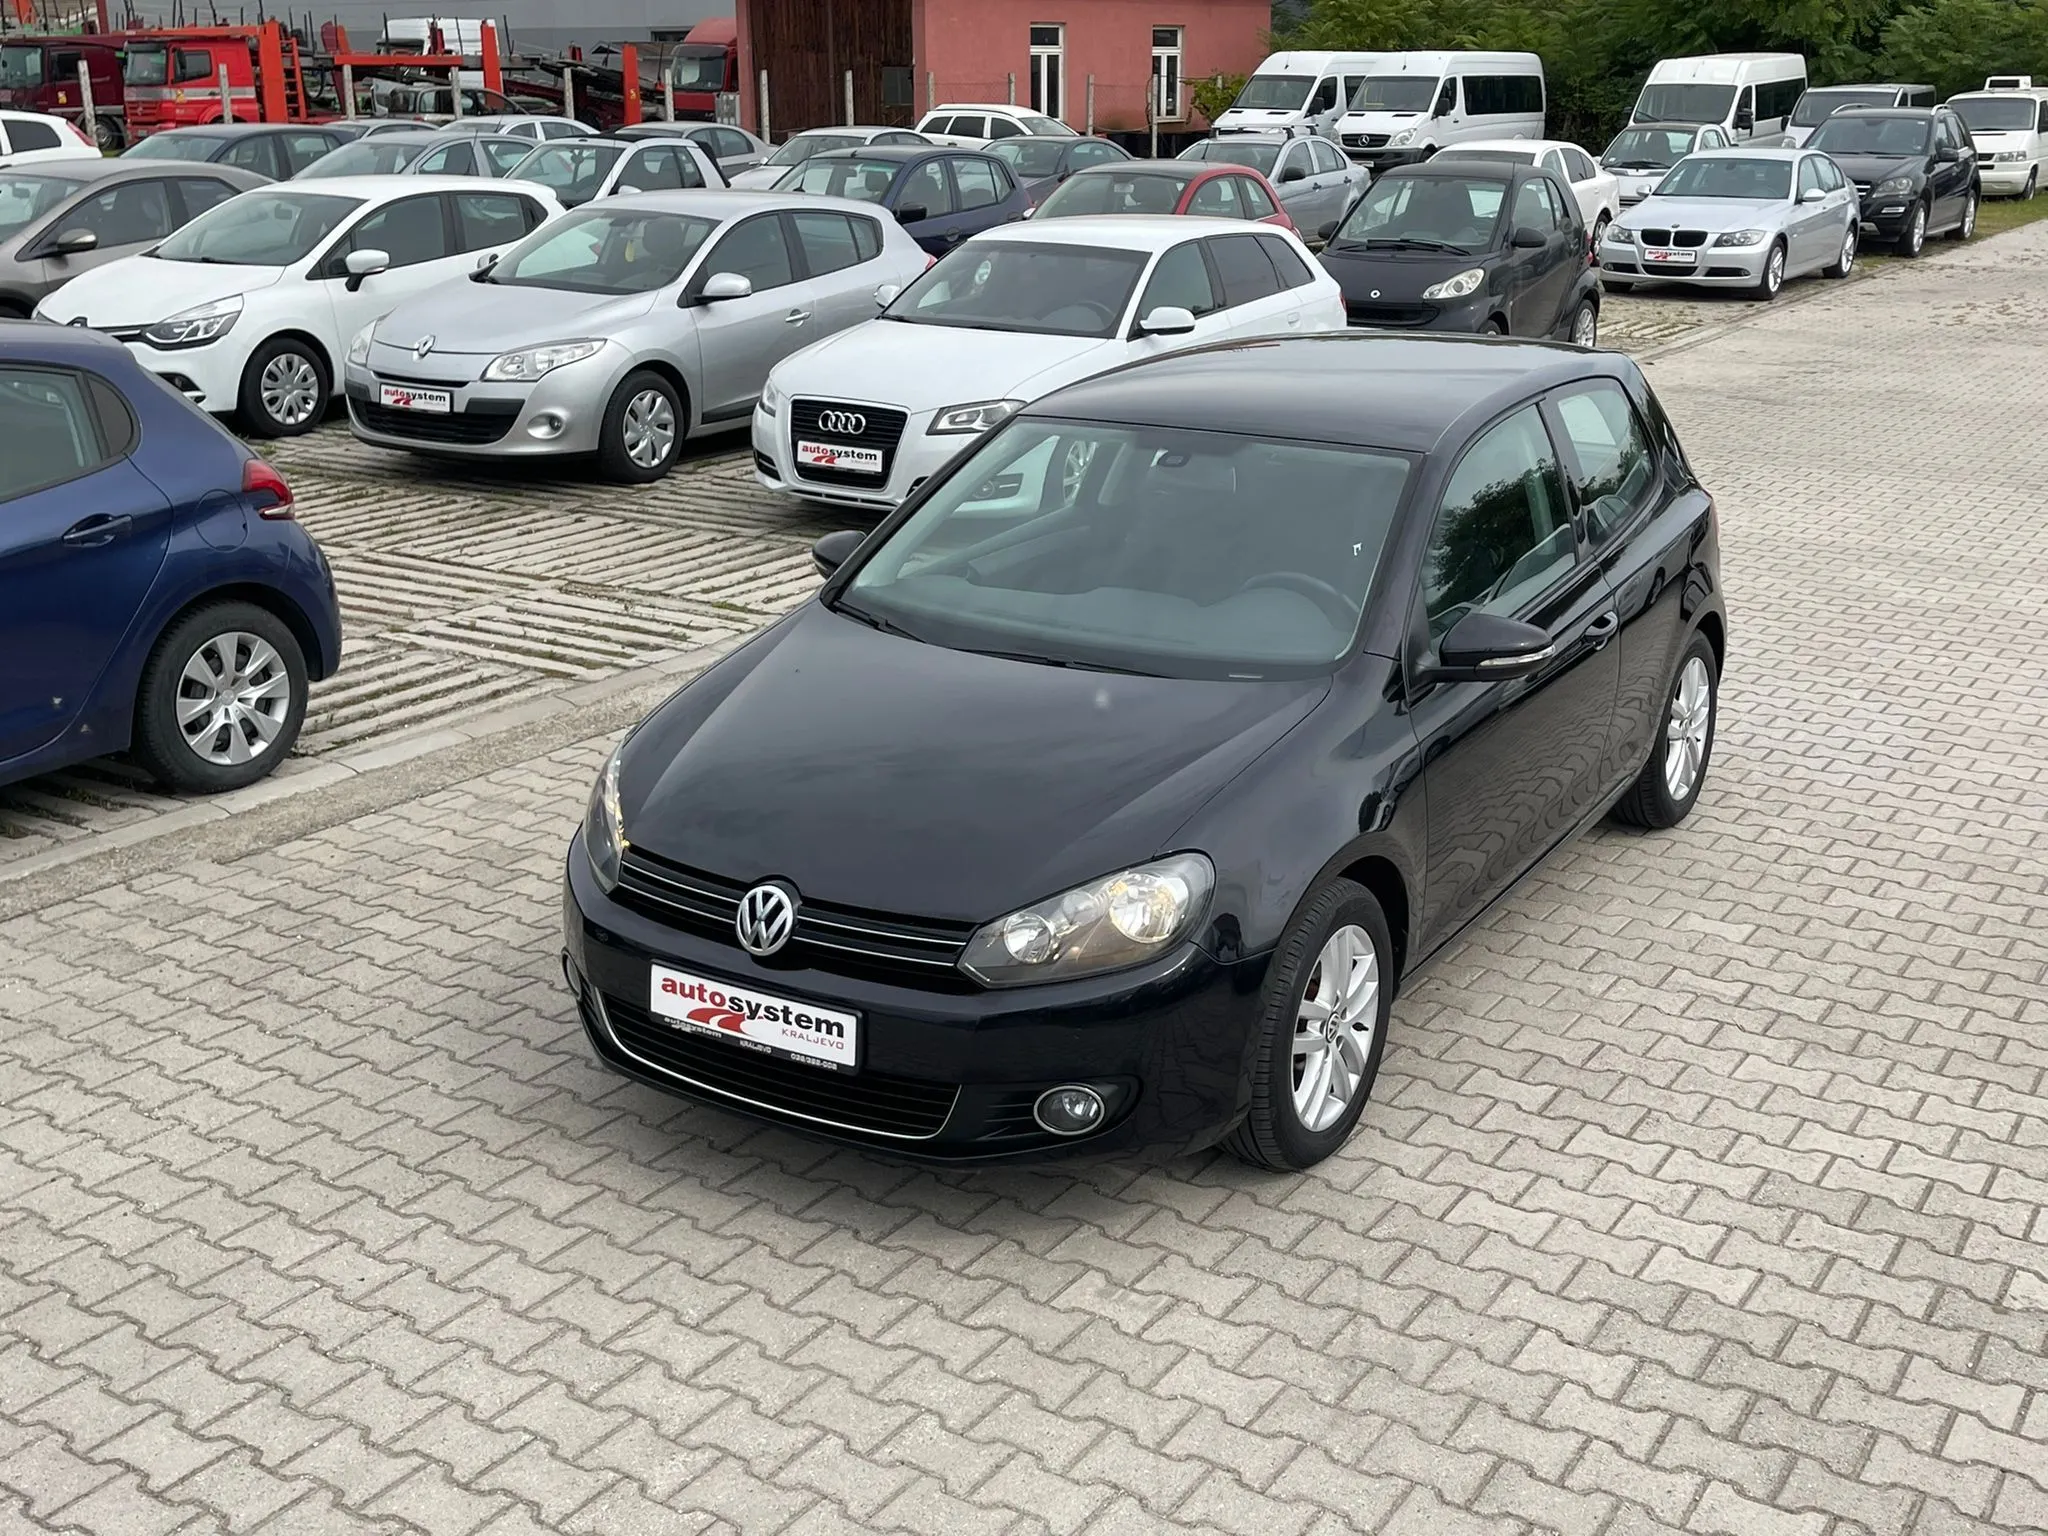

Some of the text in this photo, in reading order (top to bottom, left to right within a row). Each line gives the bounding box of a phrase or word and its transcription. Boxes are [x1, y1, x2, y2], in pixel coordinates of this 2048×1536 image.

[384, 388, 446, 402] autosystem
[802, 445, 877, 461] autosystem
[661, 977, 844, 1038] autosystem
[781, 1027, 844, 1050] KRALJEVO
